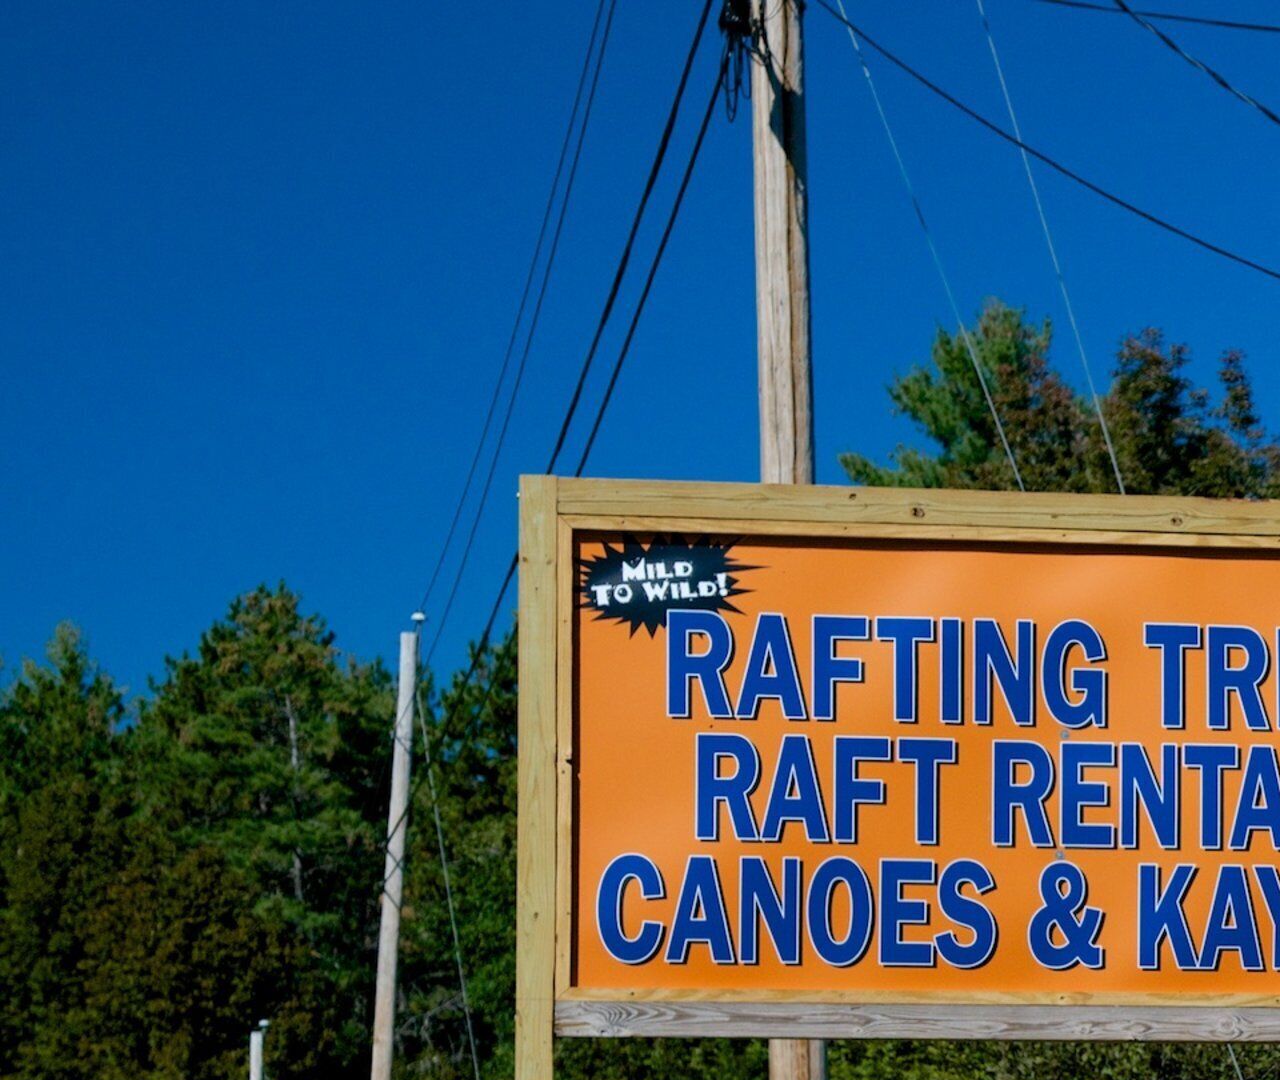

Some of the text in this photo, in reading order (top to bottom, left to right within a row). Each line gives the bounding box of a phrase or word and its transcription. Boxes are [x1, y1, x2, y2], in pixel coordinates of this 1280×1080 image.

[591, 573, 728, 606] TO WILD!
[622, 556, 693, 582] MILD
[666, 608, 1108, 729] RAFTING
[695, 732, 956, 845] RAFT
[597, 852, 998, 970] CANOES
[1027, 860, 1105, 971] &
